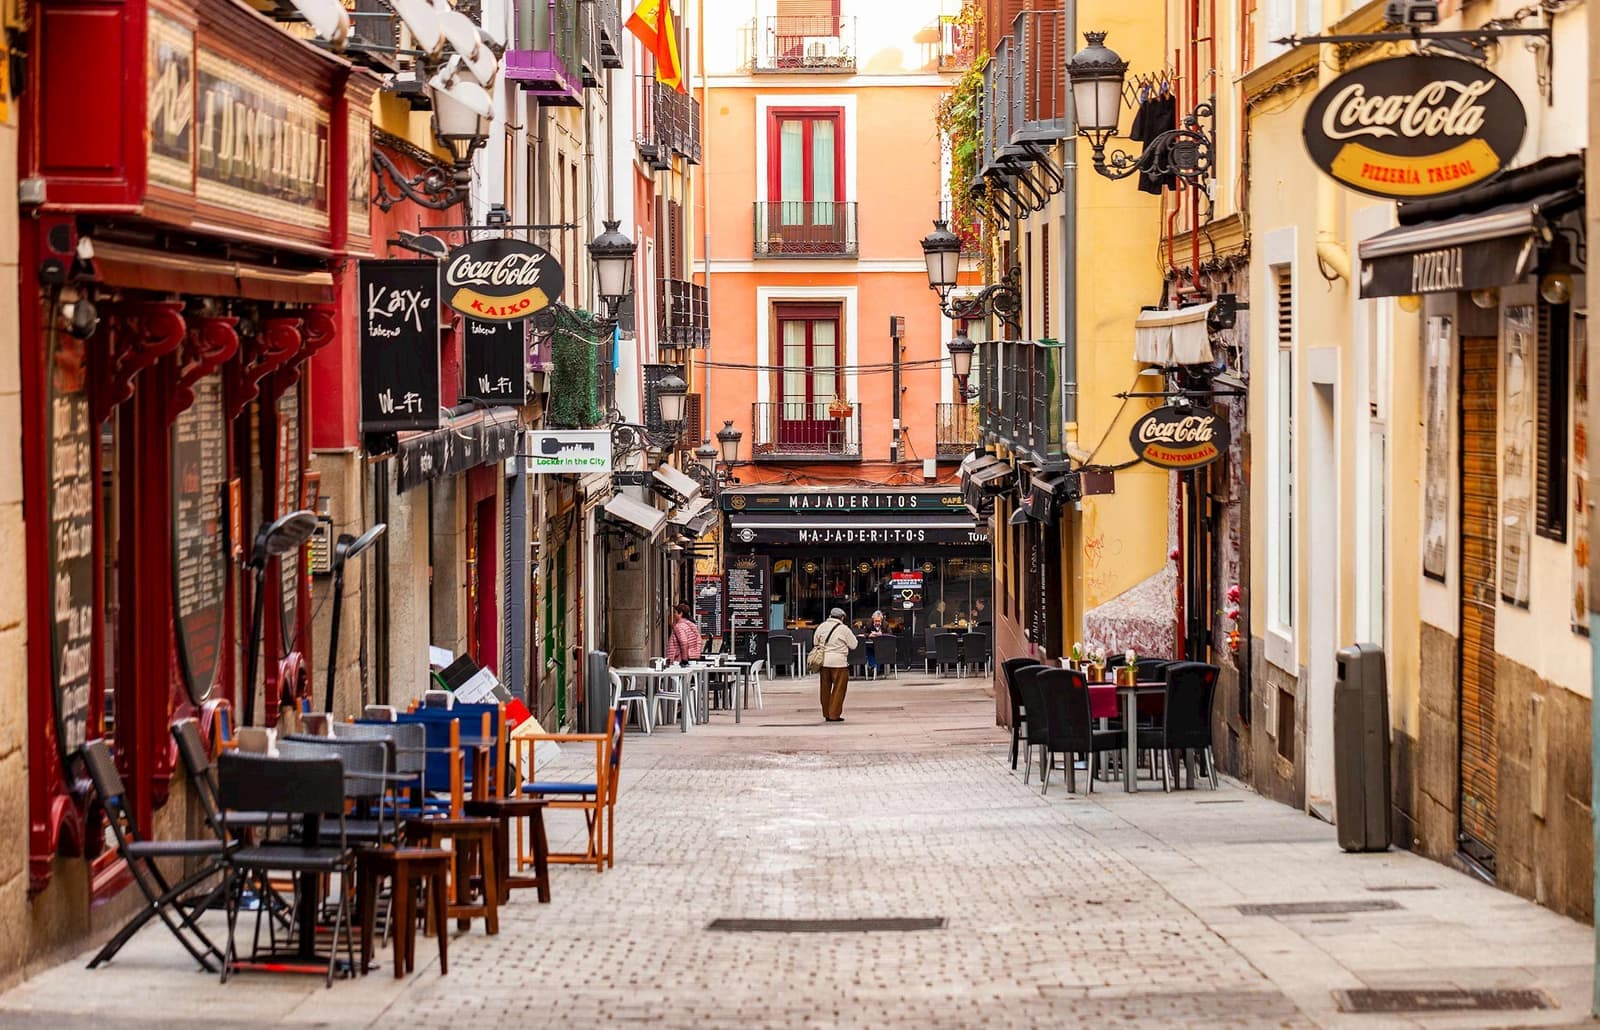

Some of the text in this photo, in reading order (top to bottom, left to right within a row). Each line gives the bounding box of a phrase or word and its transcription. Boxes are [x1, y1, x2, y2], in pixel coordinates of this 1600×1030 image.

[1360, 163, 1421, 185] PIZZERÍA
[470, 299, 531, 316] KAIXO
[1146, 447, 1159, 458] LA
[537, 457, 563, 465] Locker
[574, 457, 588, 465] the
[589, 457, 606, 466] City
[941, 496, 962, 504] CAFÉ
